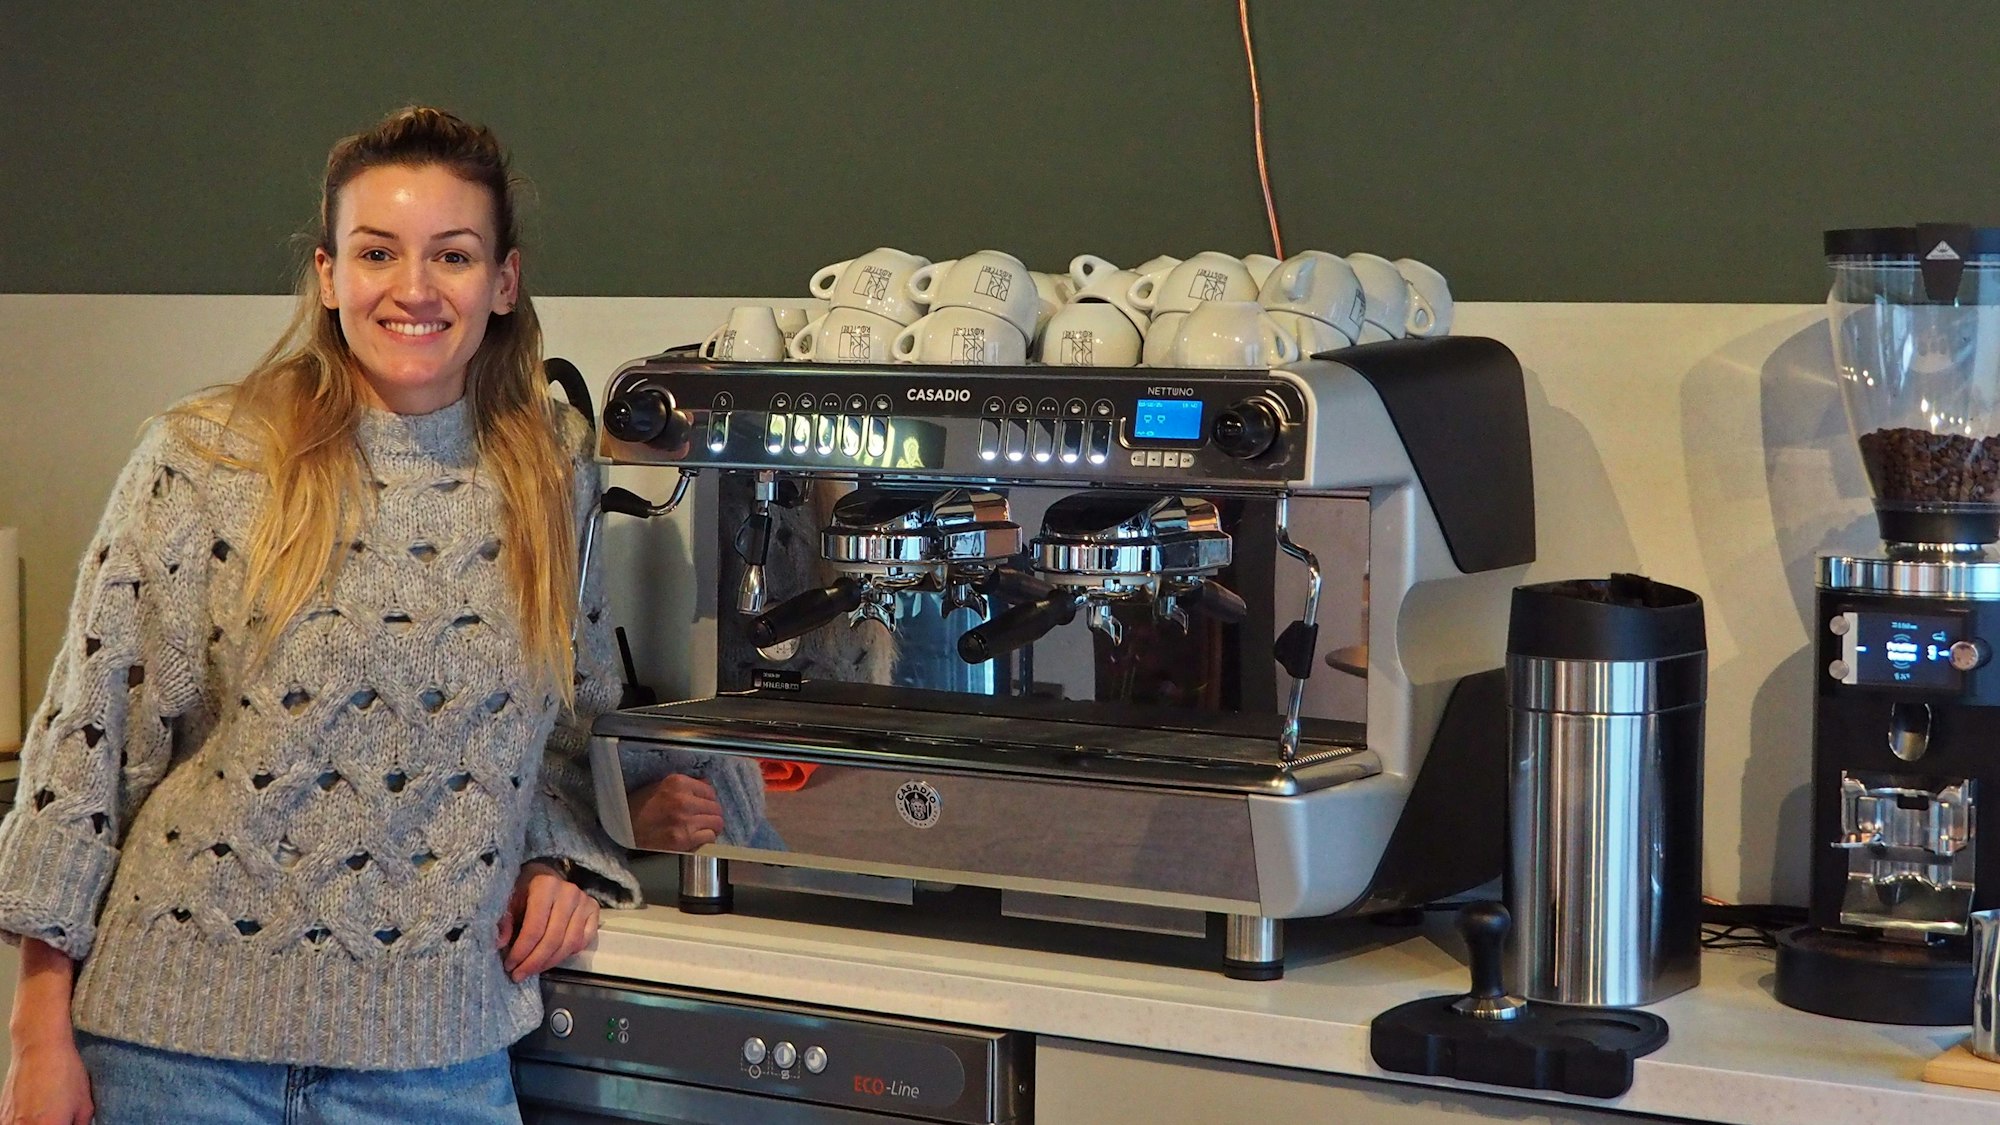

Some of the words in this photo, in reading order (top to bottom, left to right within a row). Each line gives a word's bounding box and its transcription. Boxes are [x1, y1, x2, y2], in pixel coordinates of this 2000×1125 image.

[906, 388, 971, 402] CASADIO
[1147, 386, 1194, 397] NETTUNO
[897, 784, 936, 803] CASADIO
[854, 1075, 920, 1098] ECO-Line
